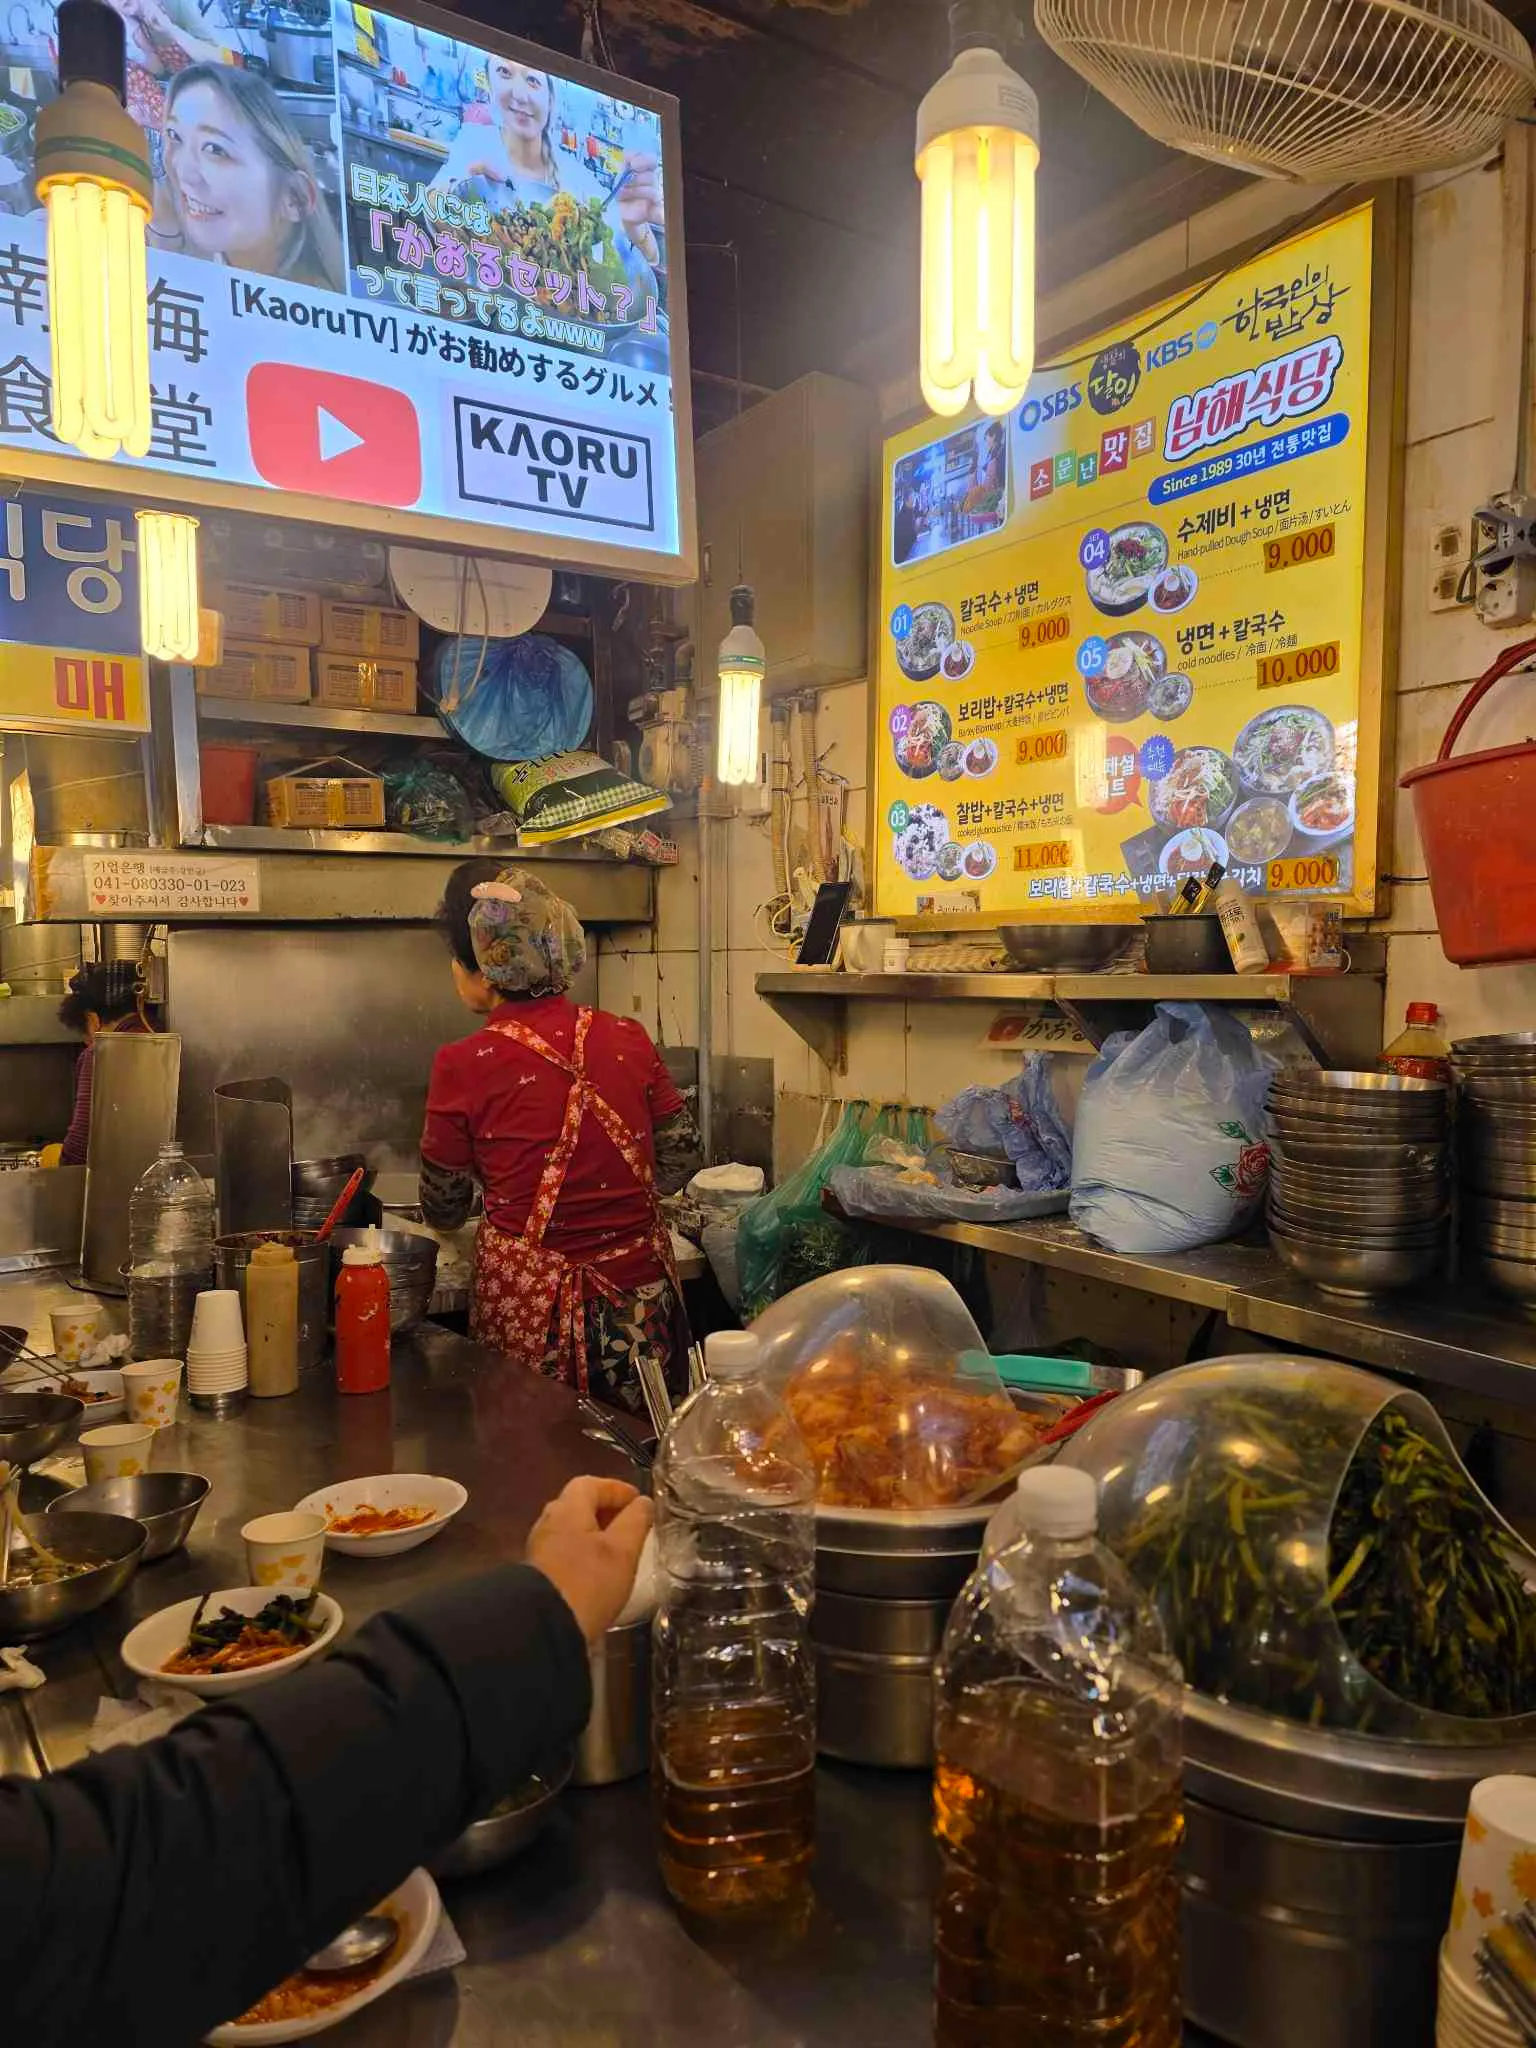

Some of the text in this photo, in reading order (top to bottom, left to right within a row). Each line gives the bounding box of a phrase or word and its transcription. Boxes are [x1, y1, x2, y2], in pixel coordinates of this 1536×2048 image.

[351, 163, 493, 235] 日本人には
[230, 278, 398, 353] [KaoruTV]
[357, 265, 606, 352] って言ってるよwww
[1146, 331, 1194, 373] KBS
[0, 355, 216, 467] 食堂
[1041, 380, 1084, 423] SBS
[1170, 344, 1334, 455] 남해식당
[470, 412, 639, 480] KAORU
[1031, 423, 1153, 491] 소문난 맛집
[1163, 422, 1332, 495] Since 1989 30년 전통맛집
[527, 465, 589, 509] TV
[1177, 502, 1236, 544] 수제비
[1255, 488, 1291, 520] 냉면
[1252, 525, 1274, 538] Soup
[1083, 540, 1105, 562] 04
[1268, 528, 1333, 569] 9.000
[960, 590, 1002, 622] 칼국수
[1014, 581, 1039, 607] 냉면
[893, 614, 908, 632] 01
[1022, 616, 1066, 648] 9.000
[1177, 621, 1214, 655] 냉면
[1233, 609, 1286, 643] 칼국수
[1080, 648, 1101, 670] 05
[1177, 656, 1196, 671] cold
[1198, 648, 1236, 667] noodles
[1258, 646, 1337, 687] 10.000
[54, 656, 126, 721] 매
[958, 682, 1069, 722] 보리밥+칼국수+냉면
[892, 714, 908, 733] 02
[1019, 734, 1064, 761] 9.000
[890, 810, 906, 826] 03
[956, 792, 1064, 825] 찰밥+칼국수+냉면
[94, 862, 145, 875] 기업은행
[94, 876, 246, 892] 041-080330-01-023
[1270, 857, 1336, 889] 9.000
[178, 894, 238, 909] 감사합니다
